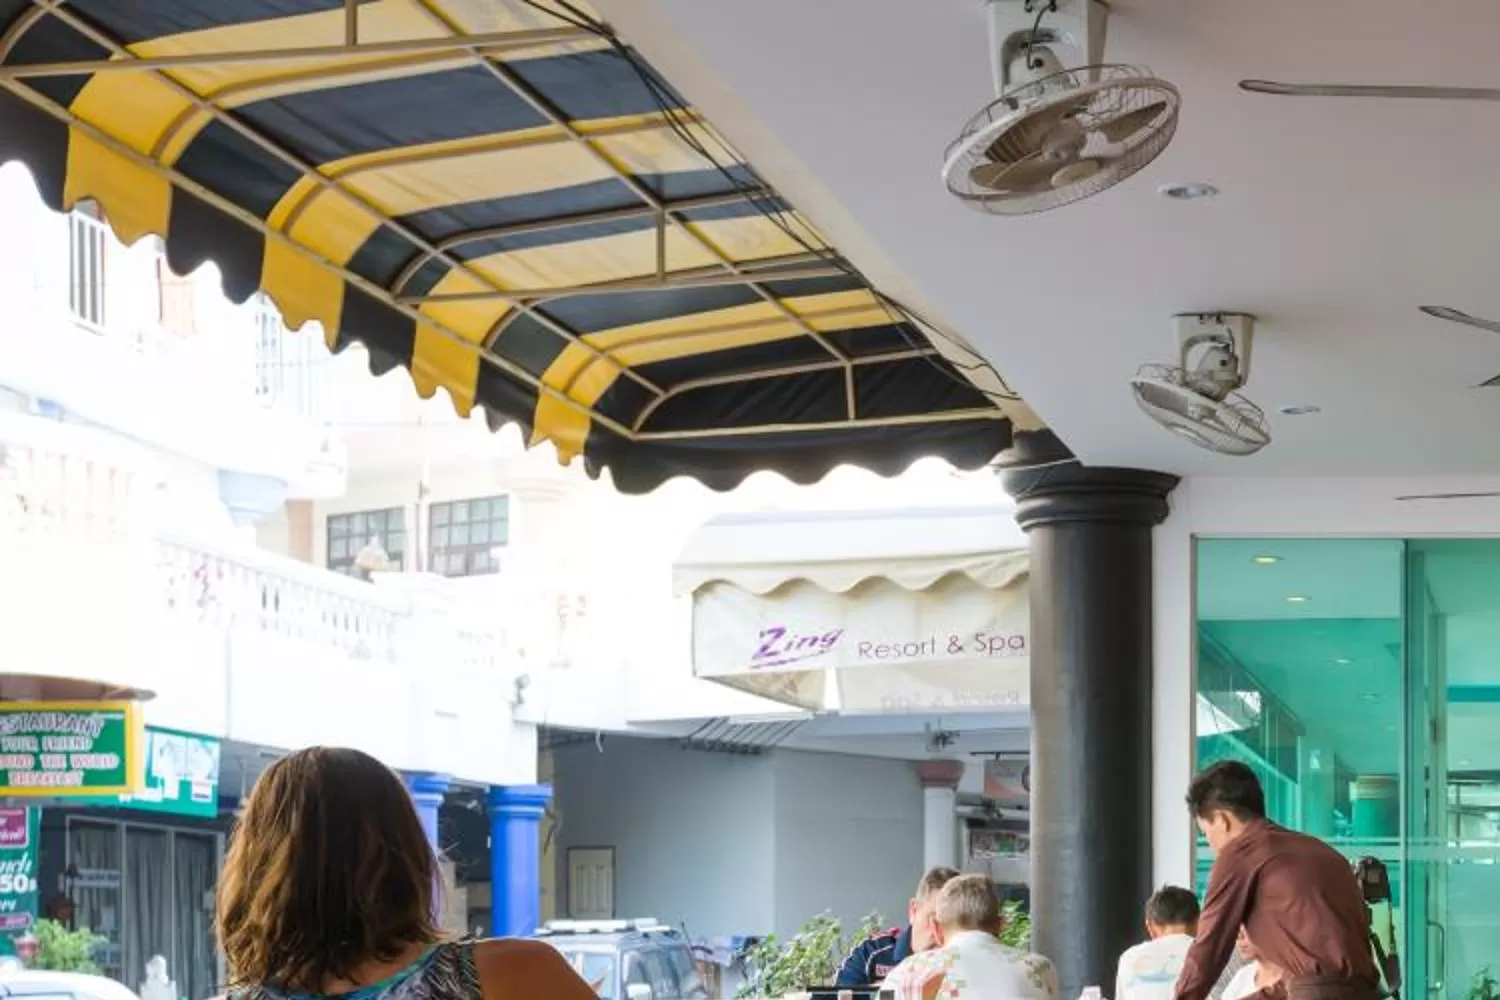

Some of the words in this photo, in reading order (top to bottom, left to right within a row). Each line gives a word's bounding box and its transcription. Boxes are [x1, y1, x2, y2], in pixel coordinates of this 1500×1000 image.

[751, 626, 845, 666] Zing
[858, 635, 936, 659] Resort
[946, 635, 965, 655] &
[973, 631, 1026, 657] Spa
